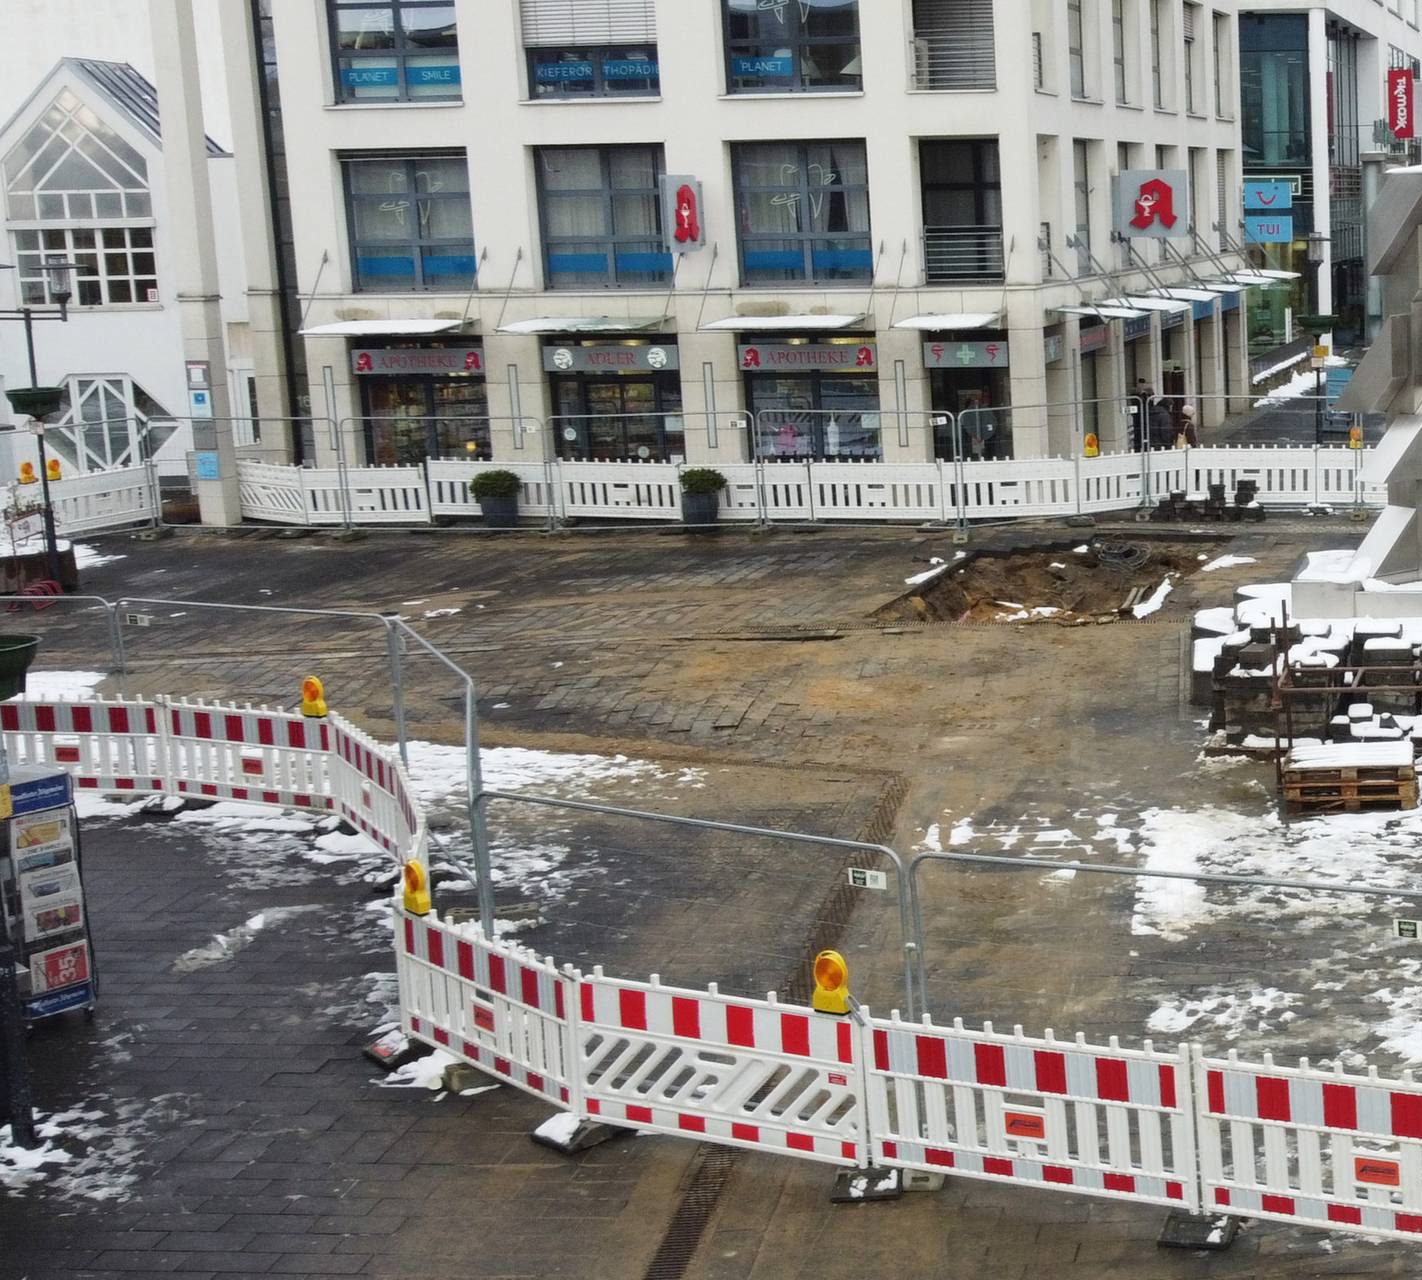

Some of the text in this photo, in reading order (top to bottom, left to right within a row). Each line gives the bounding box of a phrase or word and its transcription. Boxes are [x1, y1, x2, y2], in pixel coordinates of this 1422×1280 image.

[741, 61, 782, 72] PLANET
[348, 70, 452, 82] PLANET SMILE
[1257, 223, 1280, 235] TUI
[379, 354, 457, 368] APOTHEKE
[585, 351, 635, 365] ADLER
[766, 350, 849, 364] APOTHEKE
